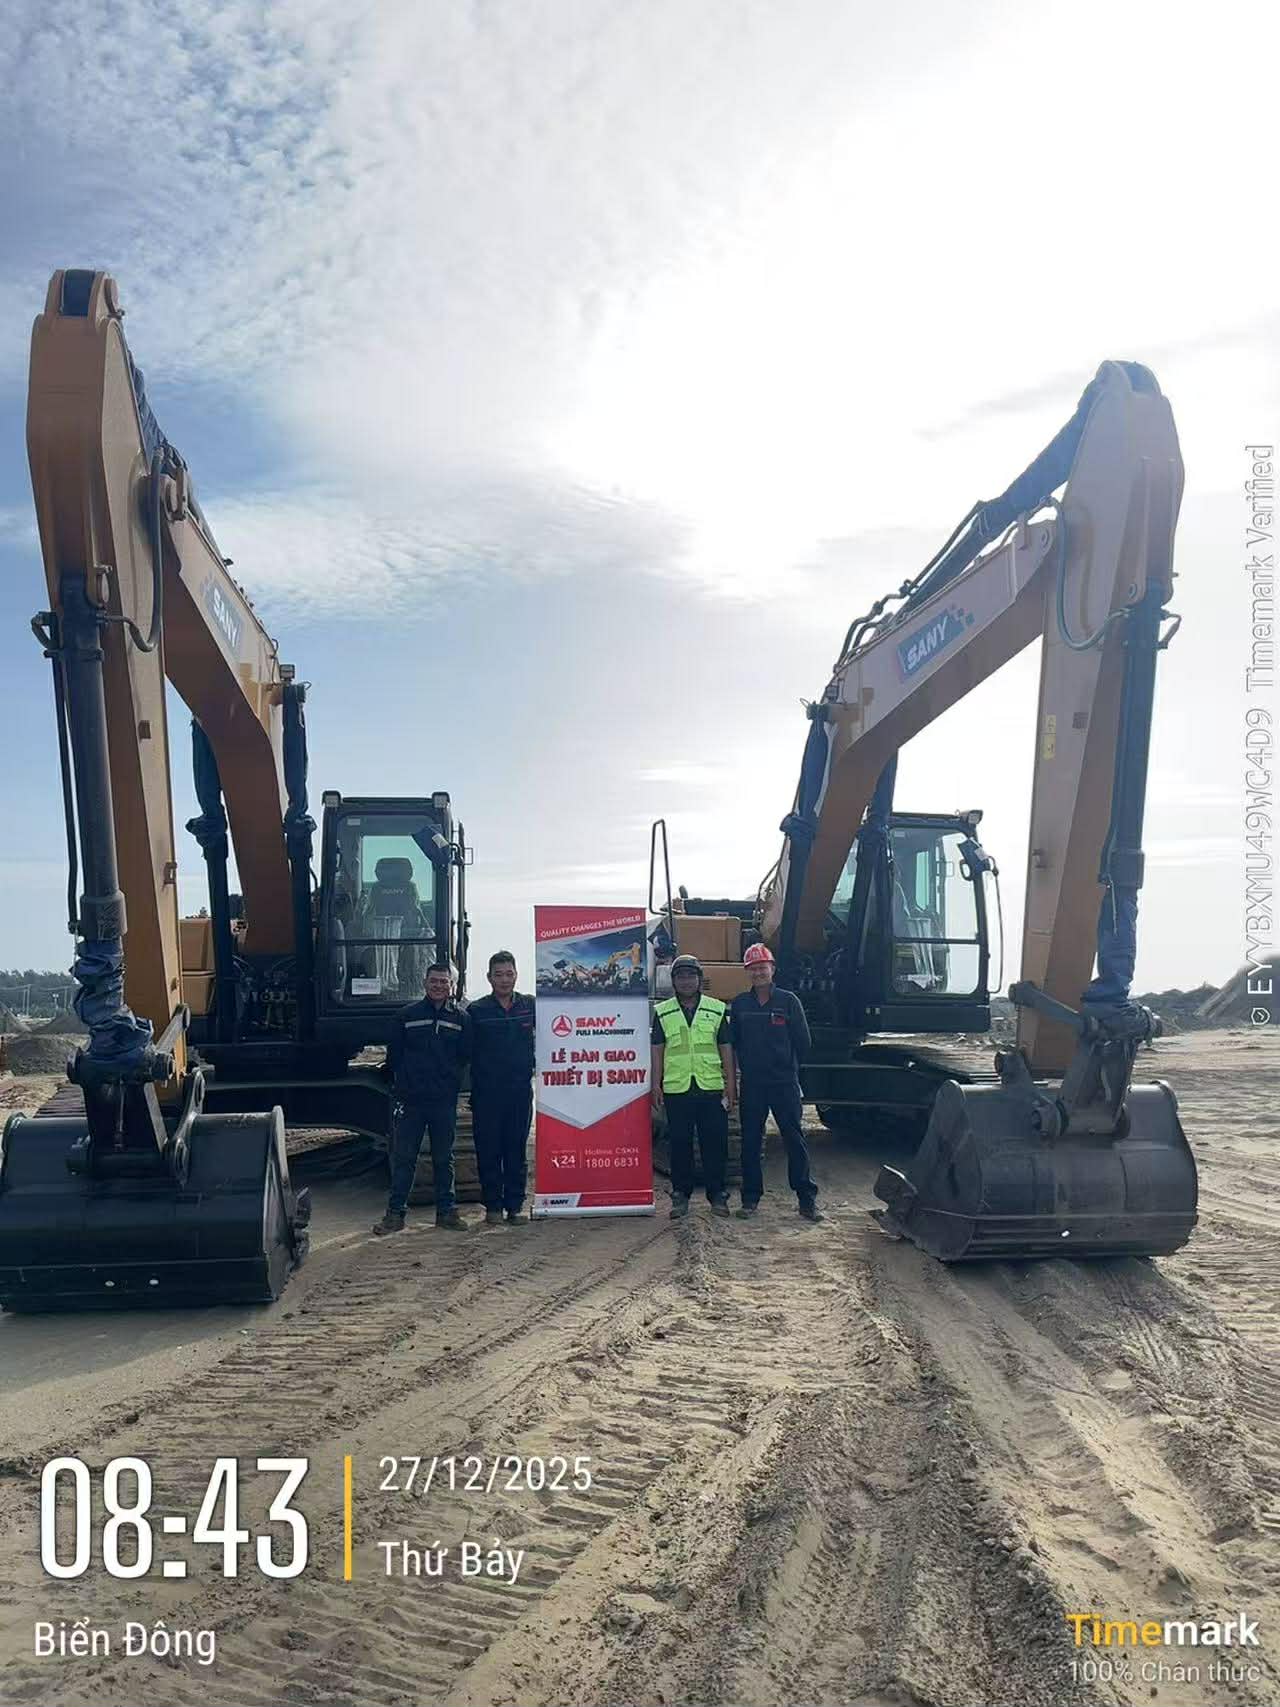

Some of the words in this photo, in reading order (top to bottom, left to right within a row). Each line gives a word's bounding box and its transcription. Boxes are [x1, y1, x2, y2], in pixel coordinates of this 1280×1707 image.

[213, 587, 237, 648] SANY
[907, 616, 948, 670] SANY
[540, 927, 570, 938] QUALITY
[571, 921, 602, 933] CHANGES
[603, 919, 616, 927] THE
[616, 914, 641, 925] WORLD
[576, 1016, 616, 1028] SANY
[592, 1028, 635, 1036] MACHINERY
[570, 1048, 600, 1063] BÀN
[603, 1049, 637, 1062] GIAO
[542, 1065, 583, 1086] THIẾT
[586, 1070, 603, 1088] BỊ
[607, 1068, 647, 1085] SANY
[560, 1155, 576, 1165] 24
[585, 1158, 611, 1169] 1800
[614, 1156, 640, 1168] 6831
